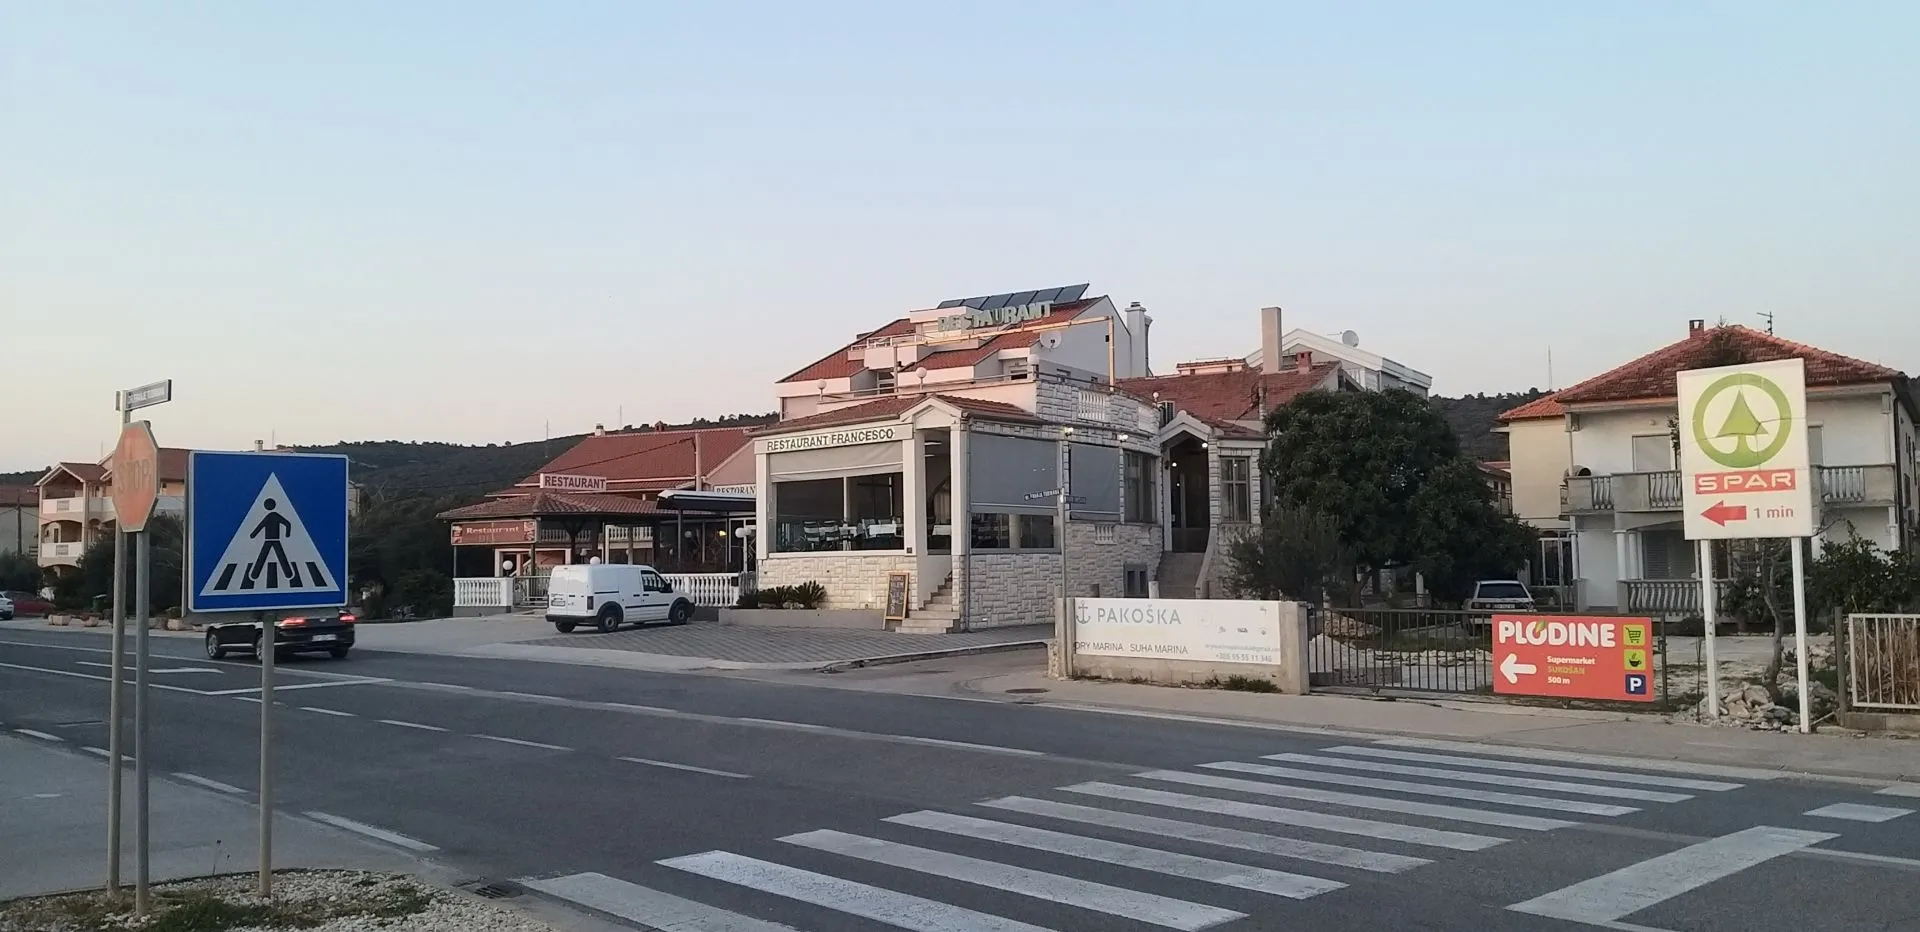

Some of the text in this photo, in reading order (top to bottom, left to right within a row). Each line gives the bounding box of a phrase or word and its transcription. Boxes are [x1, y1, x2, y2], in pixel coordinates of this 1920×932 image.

[938, 300, 1054, 331] RESTAURANT
[767, 428, 894, 451] RESTAURANT FRANCESCO
[116, 458, 152, 493] STOP
[1698, 472, 1792, 491] SPAR
[544, 476, 606, 489] RESTAURANT
[1753, 506, 1794, 519] 1 min
[466, 526, 519, 534] Restaurant
[1097, 604, 1182, 625] PAKOŠKA
[1498, 620, 1616, 647] PLODINE
[1092, 642, 1124, 651] MARINA
[1130, 643, 1153, 653] SUHA
[1155, 645, 1188, 654] MARINA
[1547, 656, 1596, 665] Supermarket
[1548, 676, 1562, 684] 500
[1630, 678, 1642, 691] P
